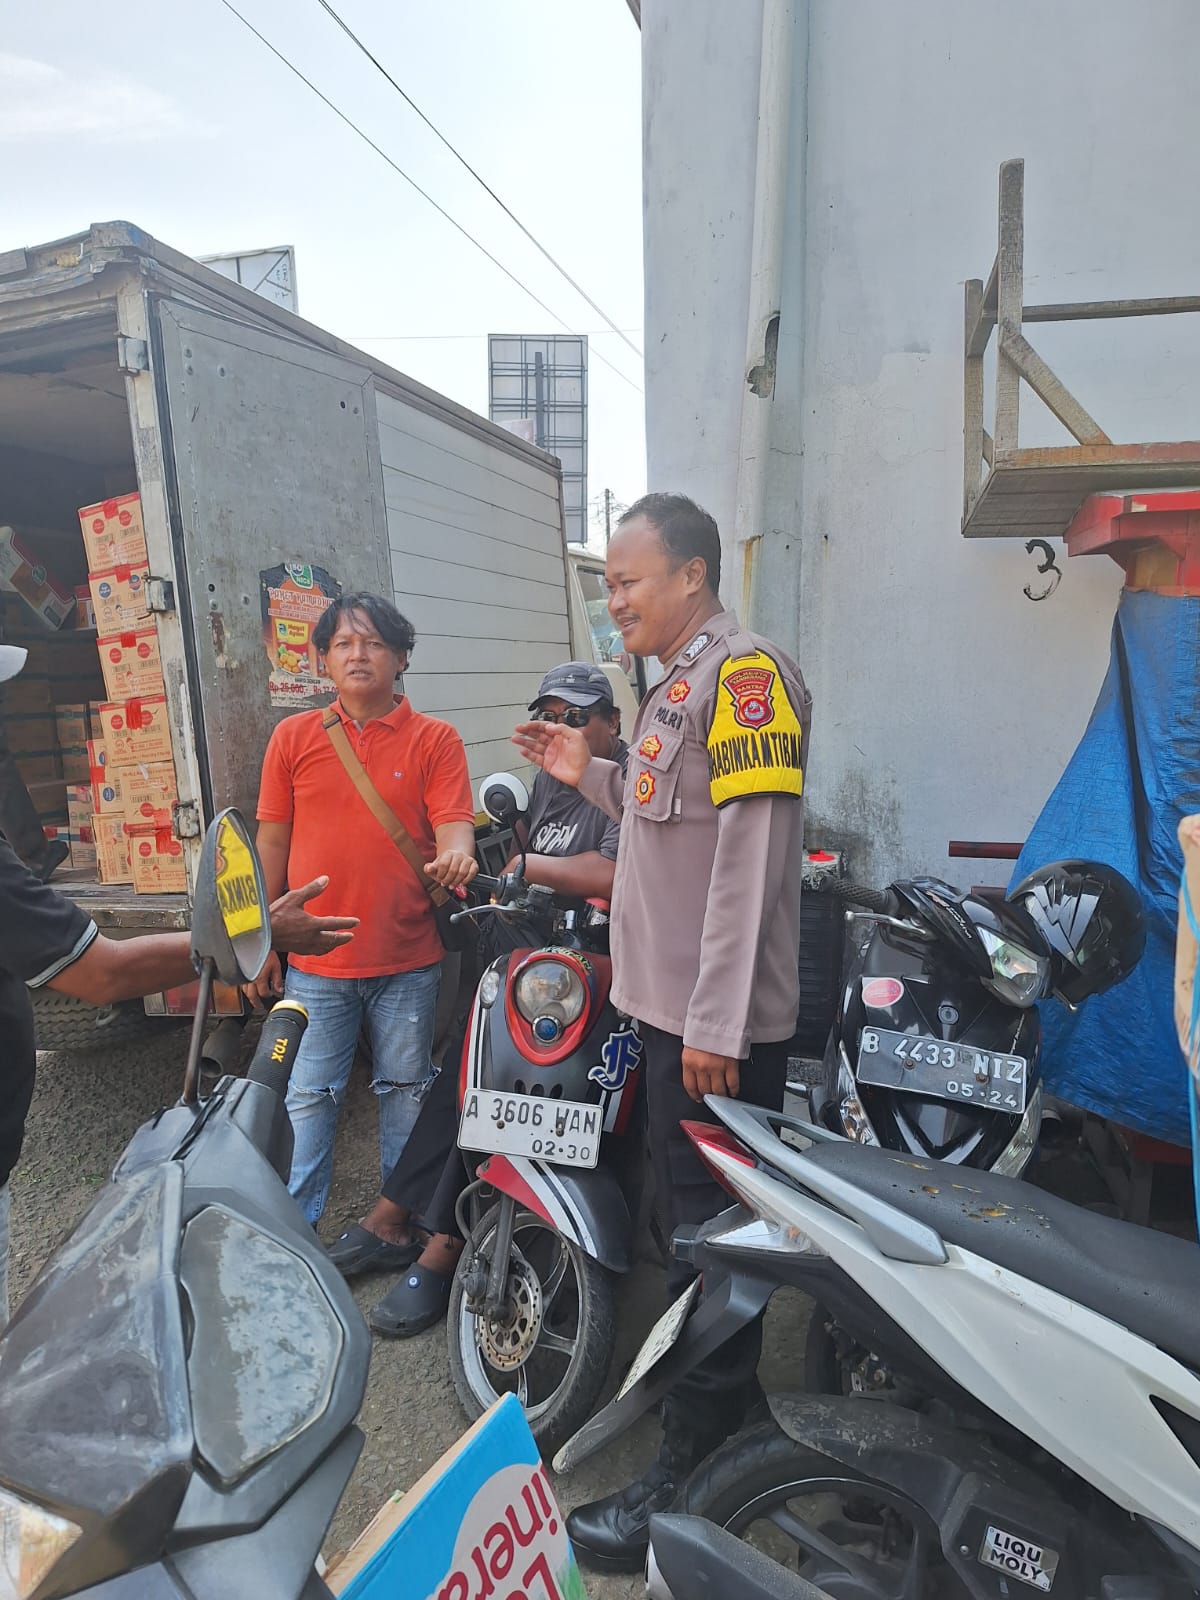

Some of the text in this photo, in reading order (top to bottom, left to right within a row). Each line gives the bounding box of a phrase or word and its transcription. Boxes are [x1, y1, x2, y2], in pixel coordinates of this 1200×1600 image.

[1023, 539, 1062, 601] 3
[654, 706, 683, 730] POLRI
[862, 1032, 1023, 1084] B 4433 NIZ
[465, 1094, 597, 1136] A 3606 WAN
[990, 1548, 1042, 1580] MOLY
[993, 1532, 1042, 1562] LIQU
